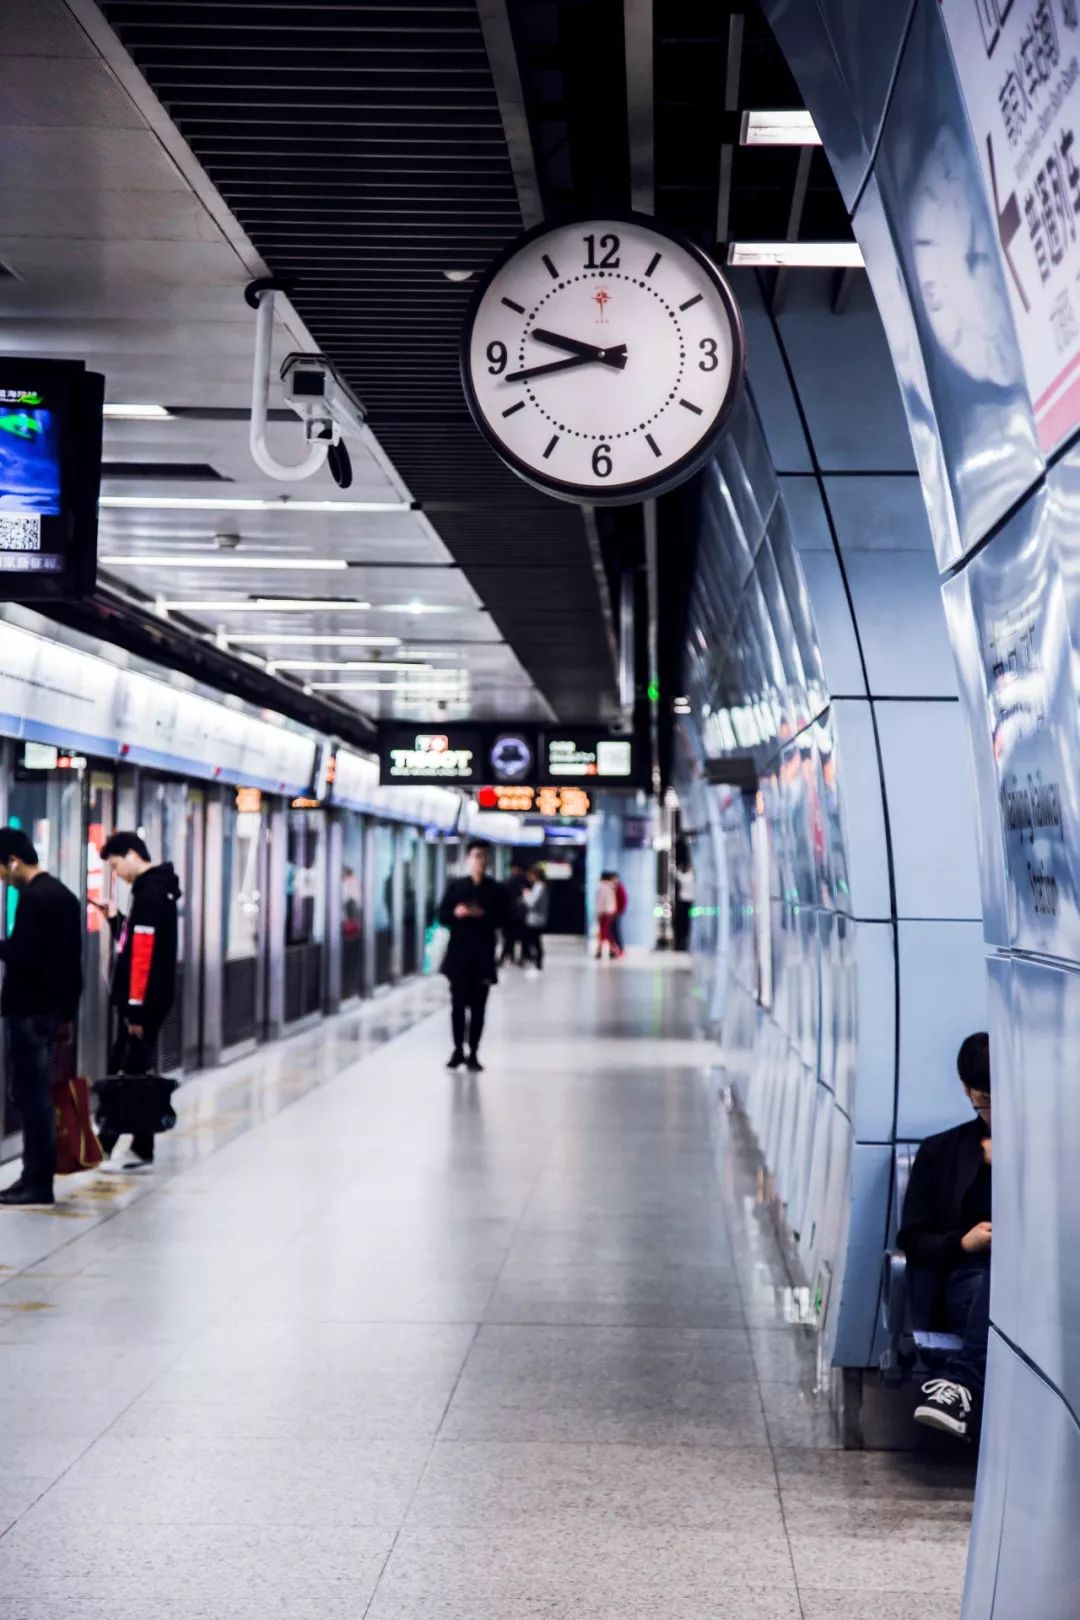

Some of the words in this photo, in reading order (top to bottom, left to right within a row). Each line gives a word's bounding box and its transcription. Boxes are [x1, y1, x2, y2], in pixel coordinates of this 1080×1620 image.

[583, 234, 621, 269] 12
[486, 340, 508, 375] 9
[698, 338, 719, 372] 3
[591, 444, 613, 478] 6
